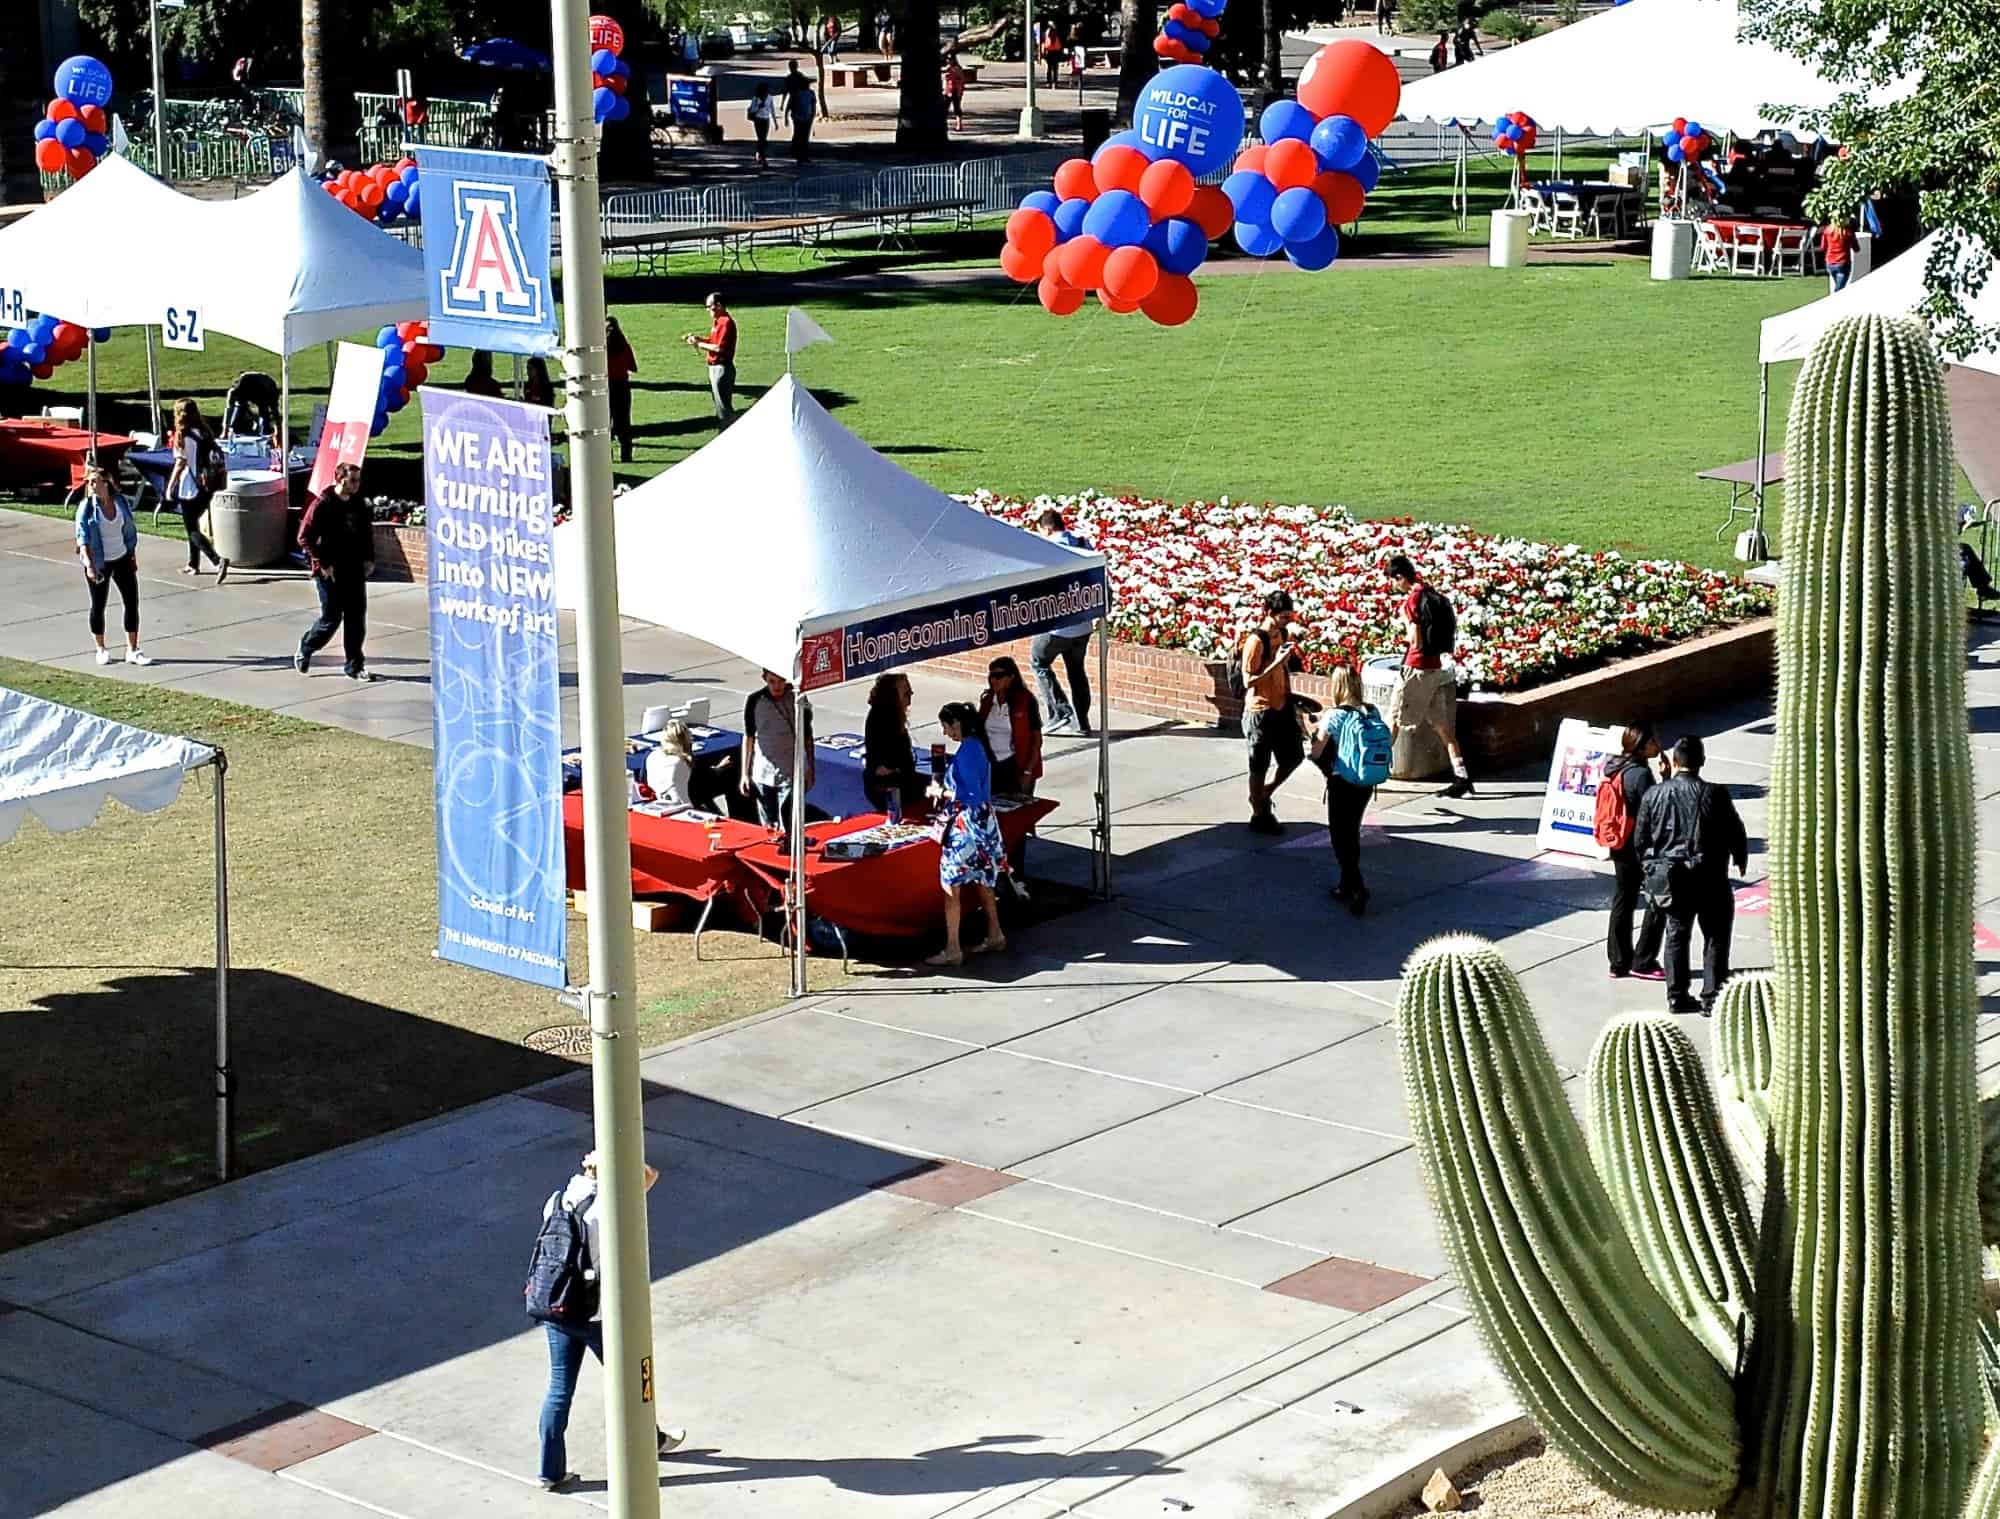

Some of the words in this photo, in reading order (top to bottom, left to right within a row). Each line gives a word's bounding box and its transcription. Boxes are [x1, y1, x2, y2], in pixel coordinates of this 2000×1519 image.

[69, 79, 106, 101] LIFE
[1150, 88, 1217, 116] WILDCAT
[1167, 106, 1188, 120] FOR
[1141, 113, 1210, 156] LIFE
[440, 179, 542, 324] A
[167, 307, 199, 343] S-Z
[431, 426, 481, 470] WE
[486, 436, 545, 481] ARE
[434, 472, 547, 535] turning
[436, 516, 487, 551] OLD
[490, 520, 550, 565] bikes
[437, 552, 485, 589] into
[490, 561, 551, 601] NEW
[439, 596, 496, 625] works
[497, 601, 521, 635] of
[523, 610, 556, 638] art
[846, 610, 988, 668] Homecoming
[991, 580, 1105, 631] Information
[469, 894, 503, 915] School
[504, 903, 518, 919] of
[517, 906, 536, 923] Art
[642, 1359, 651, 1401] 34
